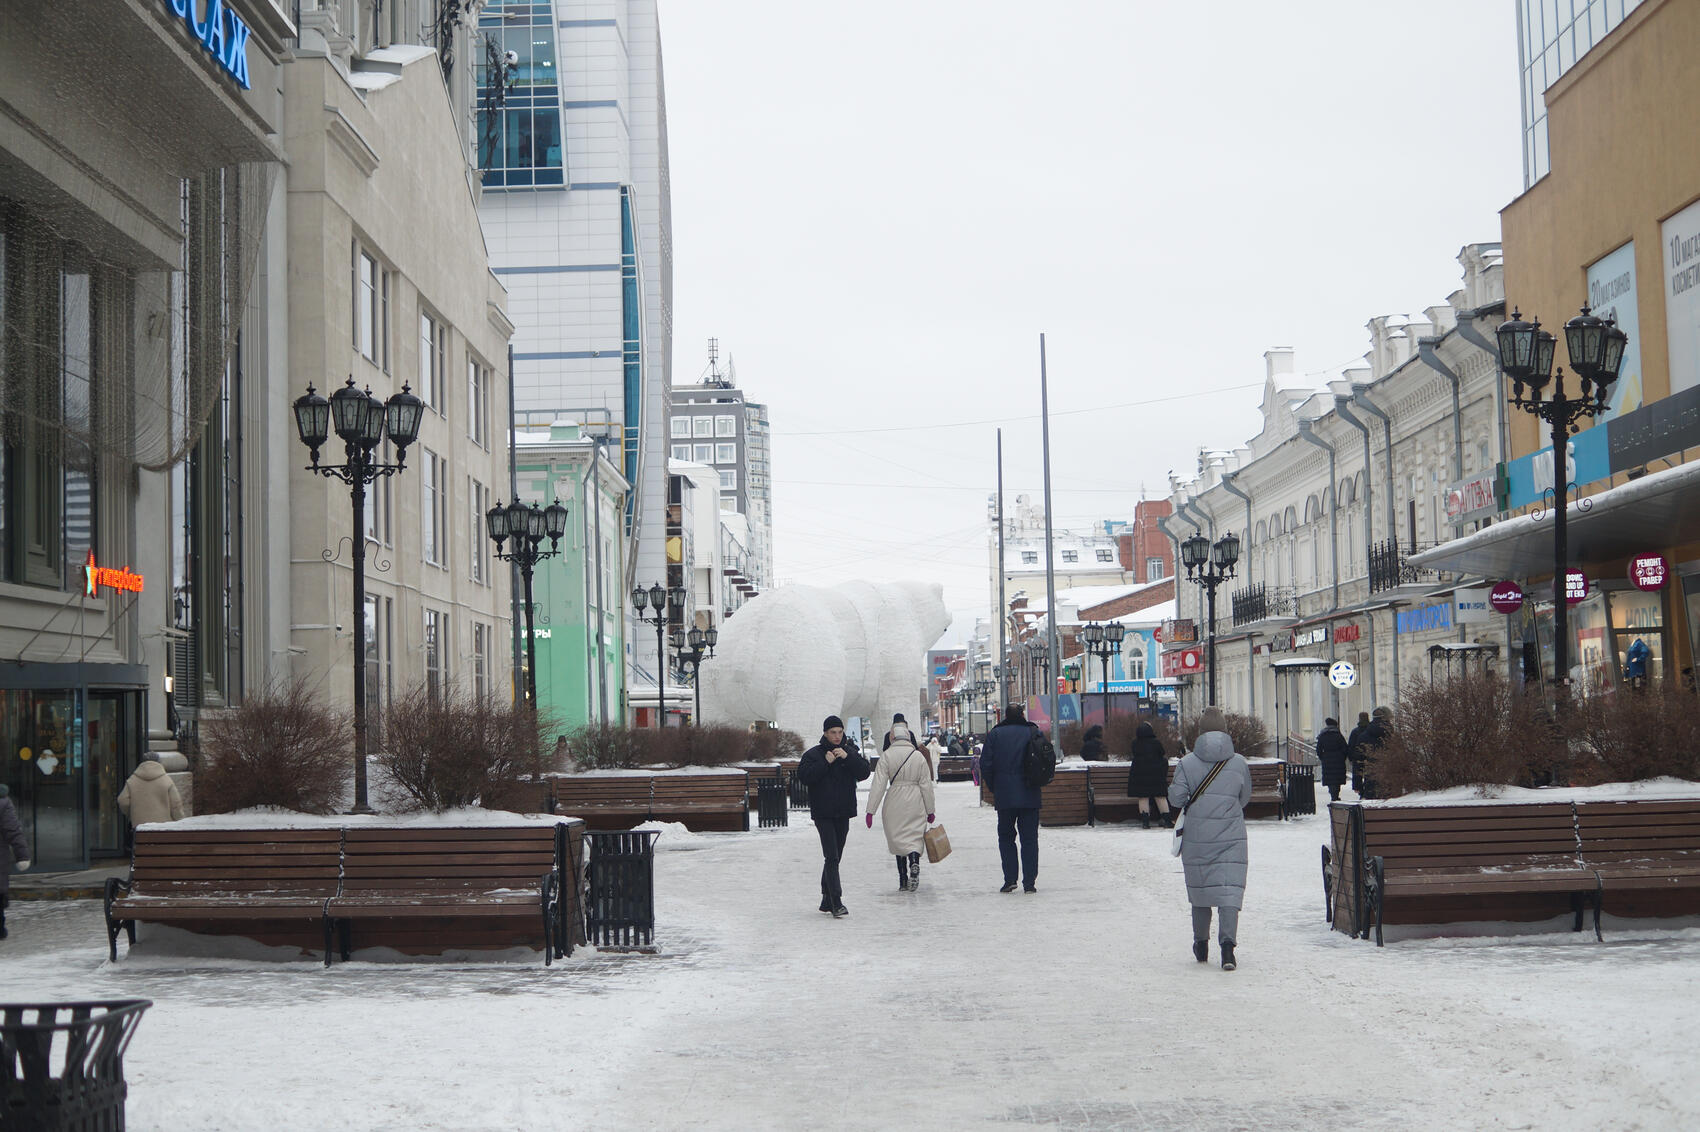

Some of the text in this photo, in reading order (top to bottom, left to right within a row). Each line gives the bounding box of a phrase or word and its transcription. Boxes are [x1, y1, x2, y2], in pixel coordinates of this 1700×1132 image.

[1670, 234, 1681, 268] 10
[1591, 271, 1631, 311] 20 МАГАЗИНОВ
[1459, 476, 1495, 513] АПТЕКА
[1636, 557, 1662, 568] РЕМОНТ
[1639, 576, 1663, 586] ГРАВЕР
